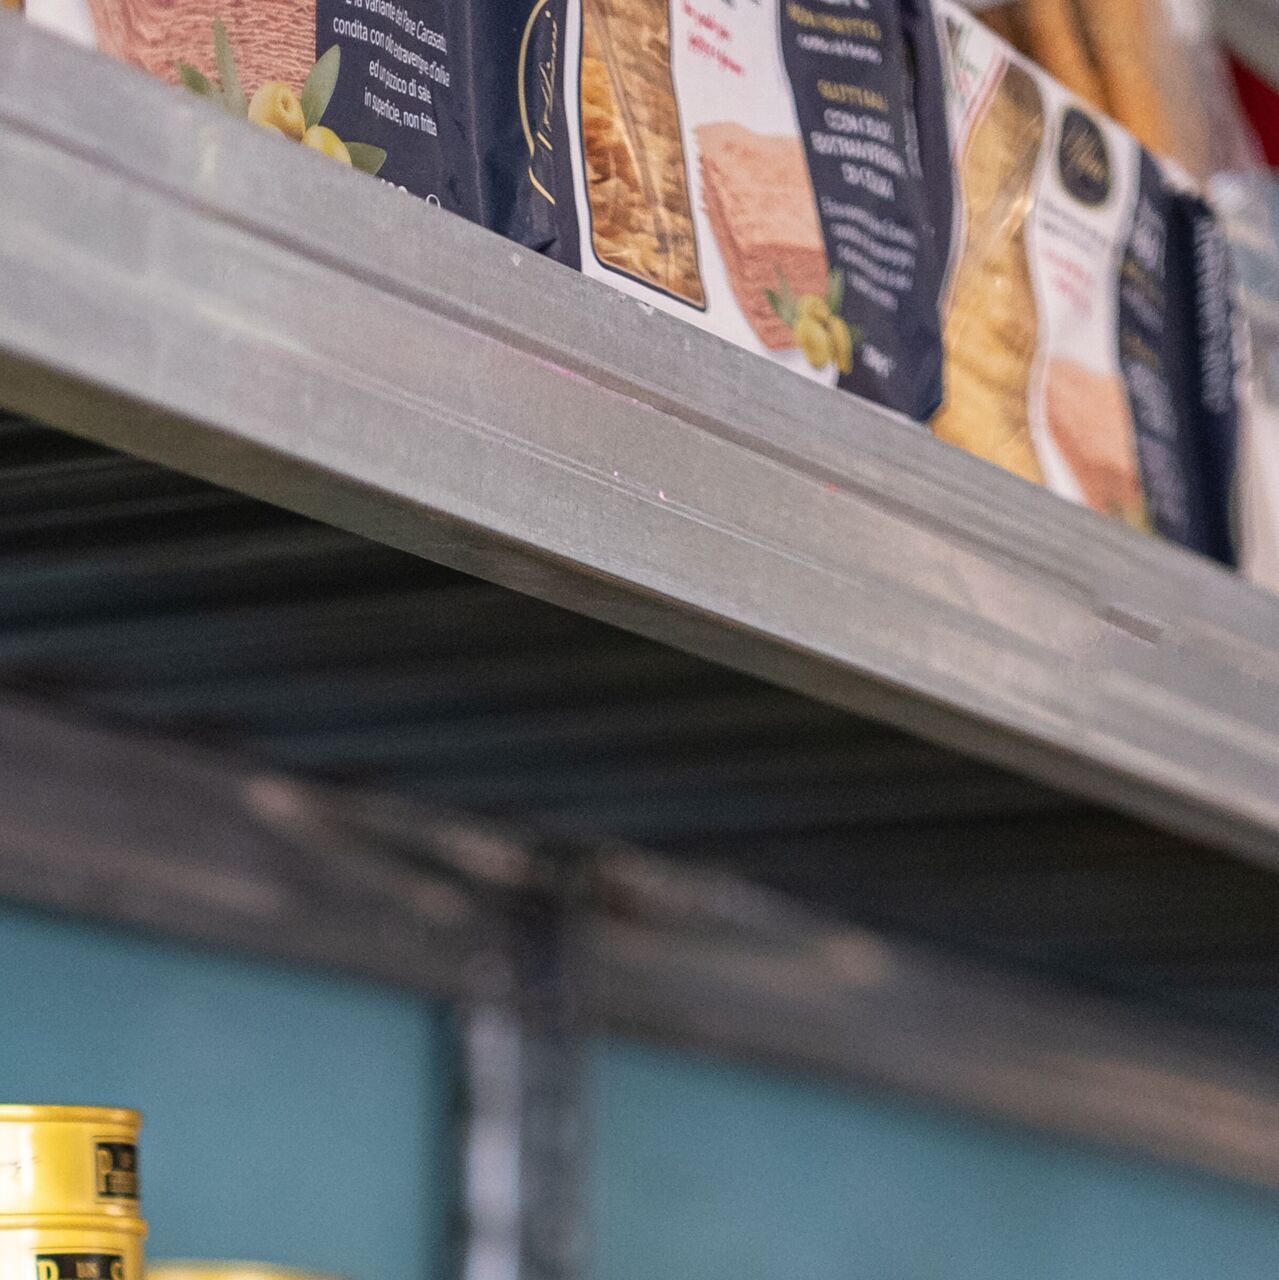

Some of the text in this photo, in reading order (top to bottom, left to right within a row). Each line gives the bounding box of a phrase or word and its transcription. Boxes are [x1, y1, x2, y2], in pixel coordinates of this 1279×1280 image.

[333, 16, 368, 41] condita
[370, 28, 385, 48] con
[369, 59, 380, 78] ed
[408, 78, 417, 98] di
[364, 86, 372, 107] in
[403, 111, 420, 130] non
